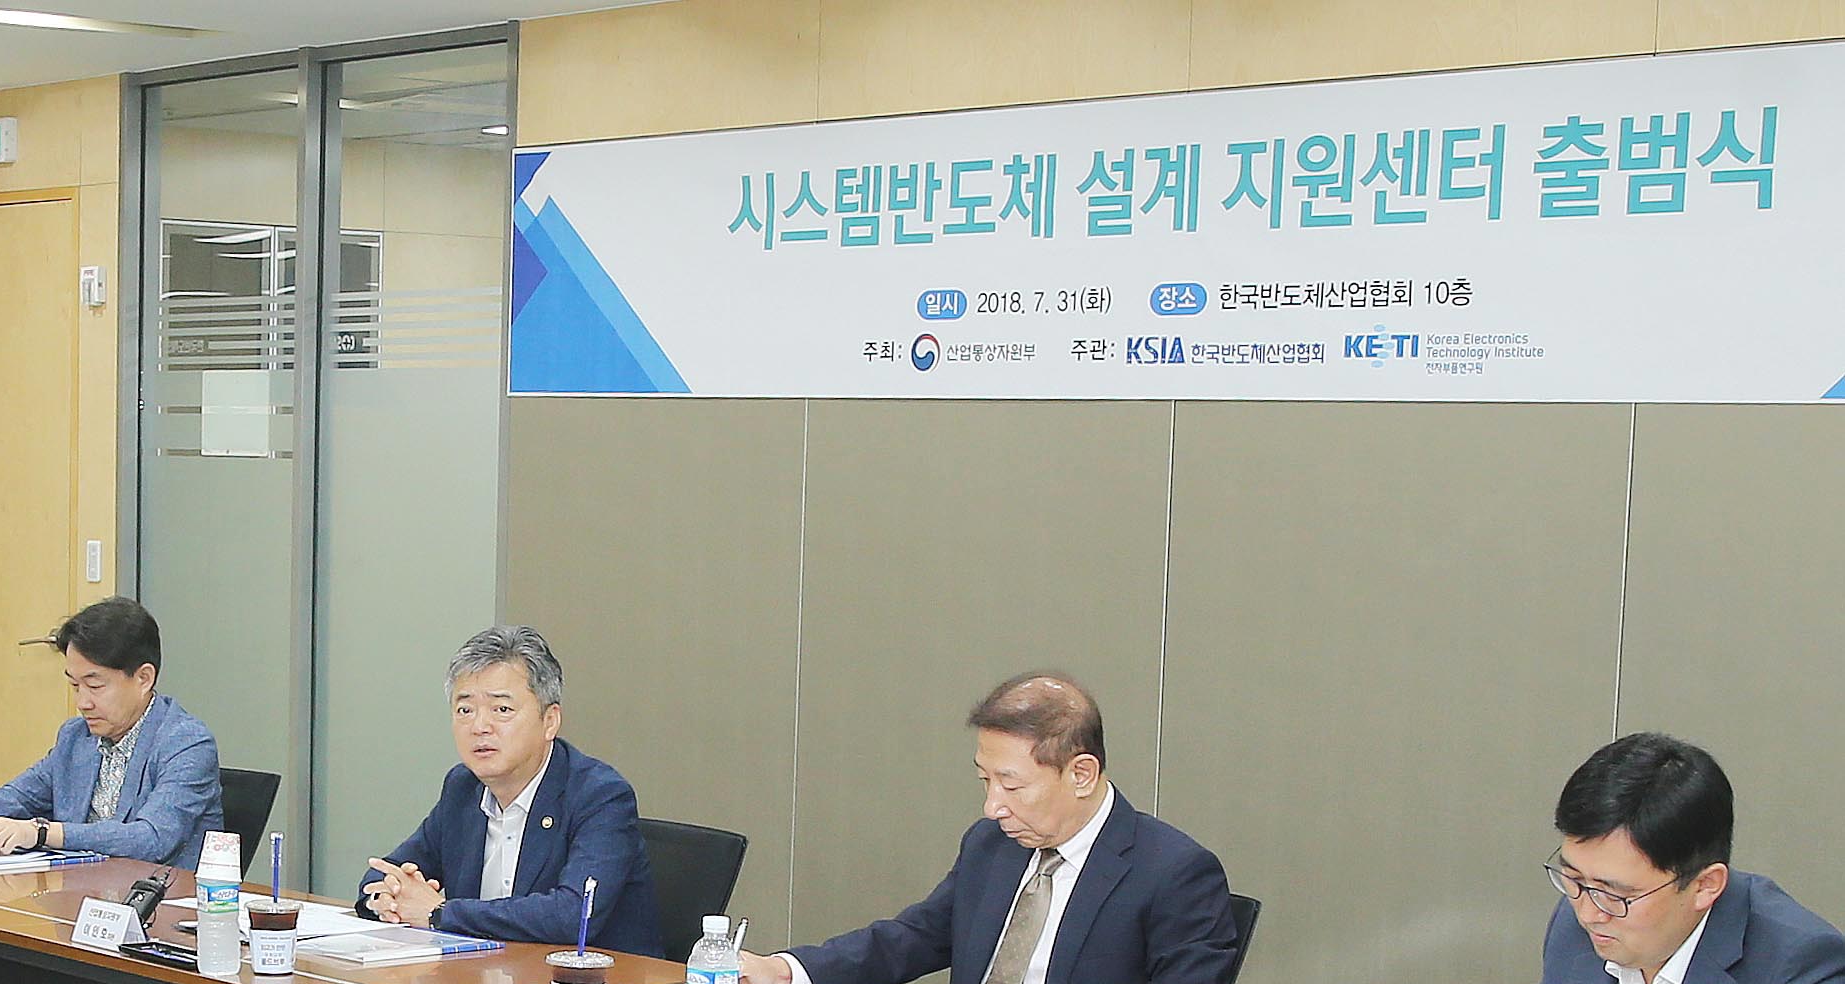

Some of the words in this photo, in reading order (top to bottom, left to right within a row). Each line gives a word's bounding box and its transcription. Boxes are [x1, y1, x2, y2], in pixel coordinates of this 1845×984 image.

[726, 152, 1057, 252] 시스템반도체
[1076, 143, 1202, 238] 설계
[1221, 123, 1507, 230] 지원센터
[1533, 105, 1778, 219] 출범식
[924, 291, 960, 316] 일시
[976, 290, 1026, 314] 2018.
[1033, 291, 1050, 314] 7.
[1056, 286, 1112, 315] 31(화)
[1157, 286, 1198, 311] 장소
[1219, 279, 1413, 310] 한국반도체산업협회
[1424, 278, 1473, 307] 10층
[1070, 339, 1115, 361] 주관:
[1126, 336, 1185, 364] KSIA
[1343, 334, 1420, 358] KETI
[1427, 334, 1460, 345] Korea
[1463, 333, 1529, 345] Electronics
[862, 341, 903, 362] 주최:
[946, 343, 1036, 362] 산업통상자원부
[1191, 343, 1325, 364] 한국반도체산업협회
[1426, 346, 1490, 359] Technology
[1494, 346, 1544, 358] Institute
